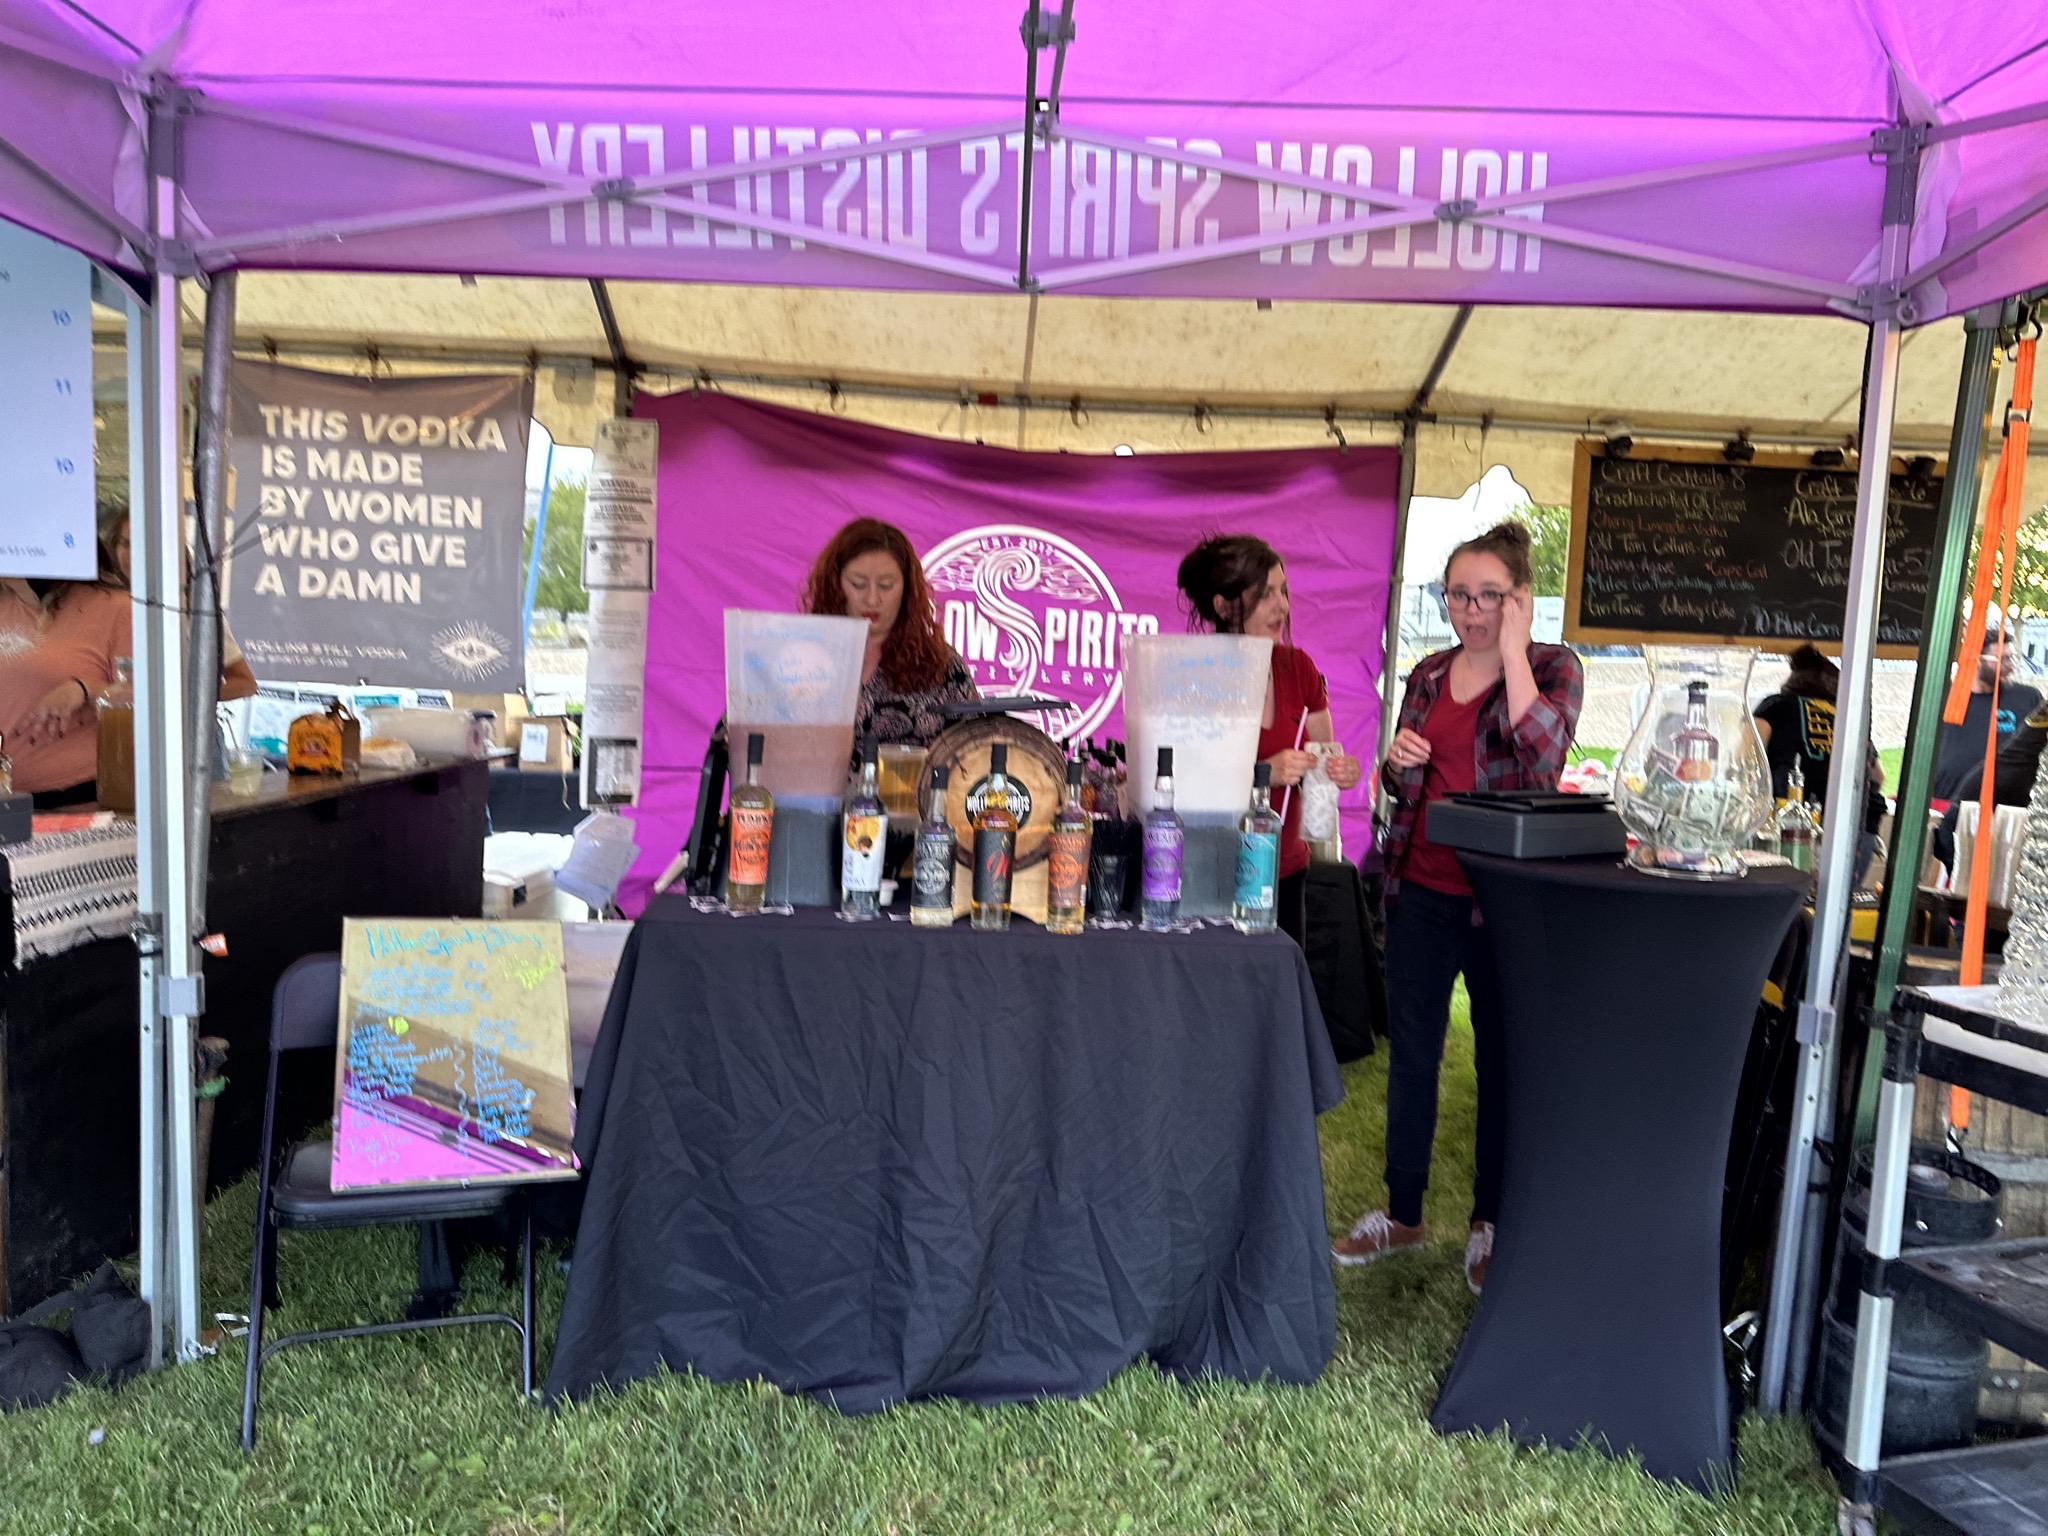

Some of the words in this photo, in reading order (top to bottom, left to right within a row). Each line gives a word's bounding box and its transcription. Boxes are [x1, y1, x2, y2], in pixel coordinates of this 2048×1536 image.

[258, 403, 349, 442] THIS
[361, 412, 507, 452] VODKA
[261, 443, 297, 479] IS
[306, 447, 424, 487] MADE
[259, 484, 313, 519] BY
[322, 487, 483, 529] WOMEN
[257, 522, 360, 561] WHO
[370, 530, 468, 568] GIVE
[254, 563, 287, 597] A
[298, 565, 422, 604] DAMN
